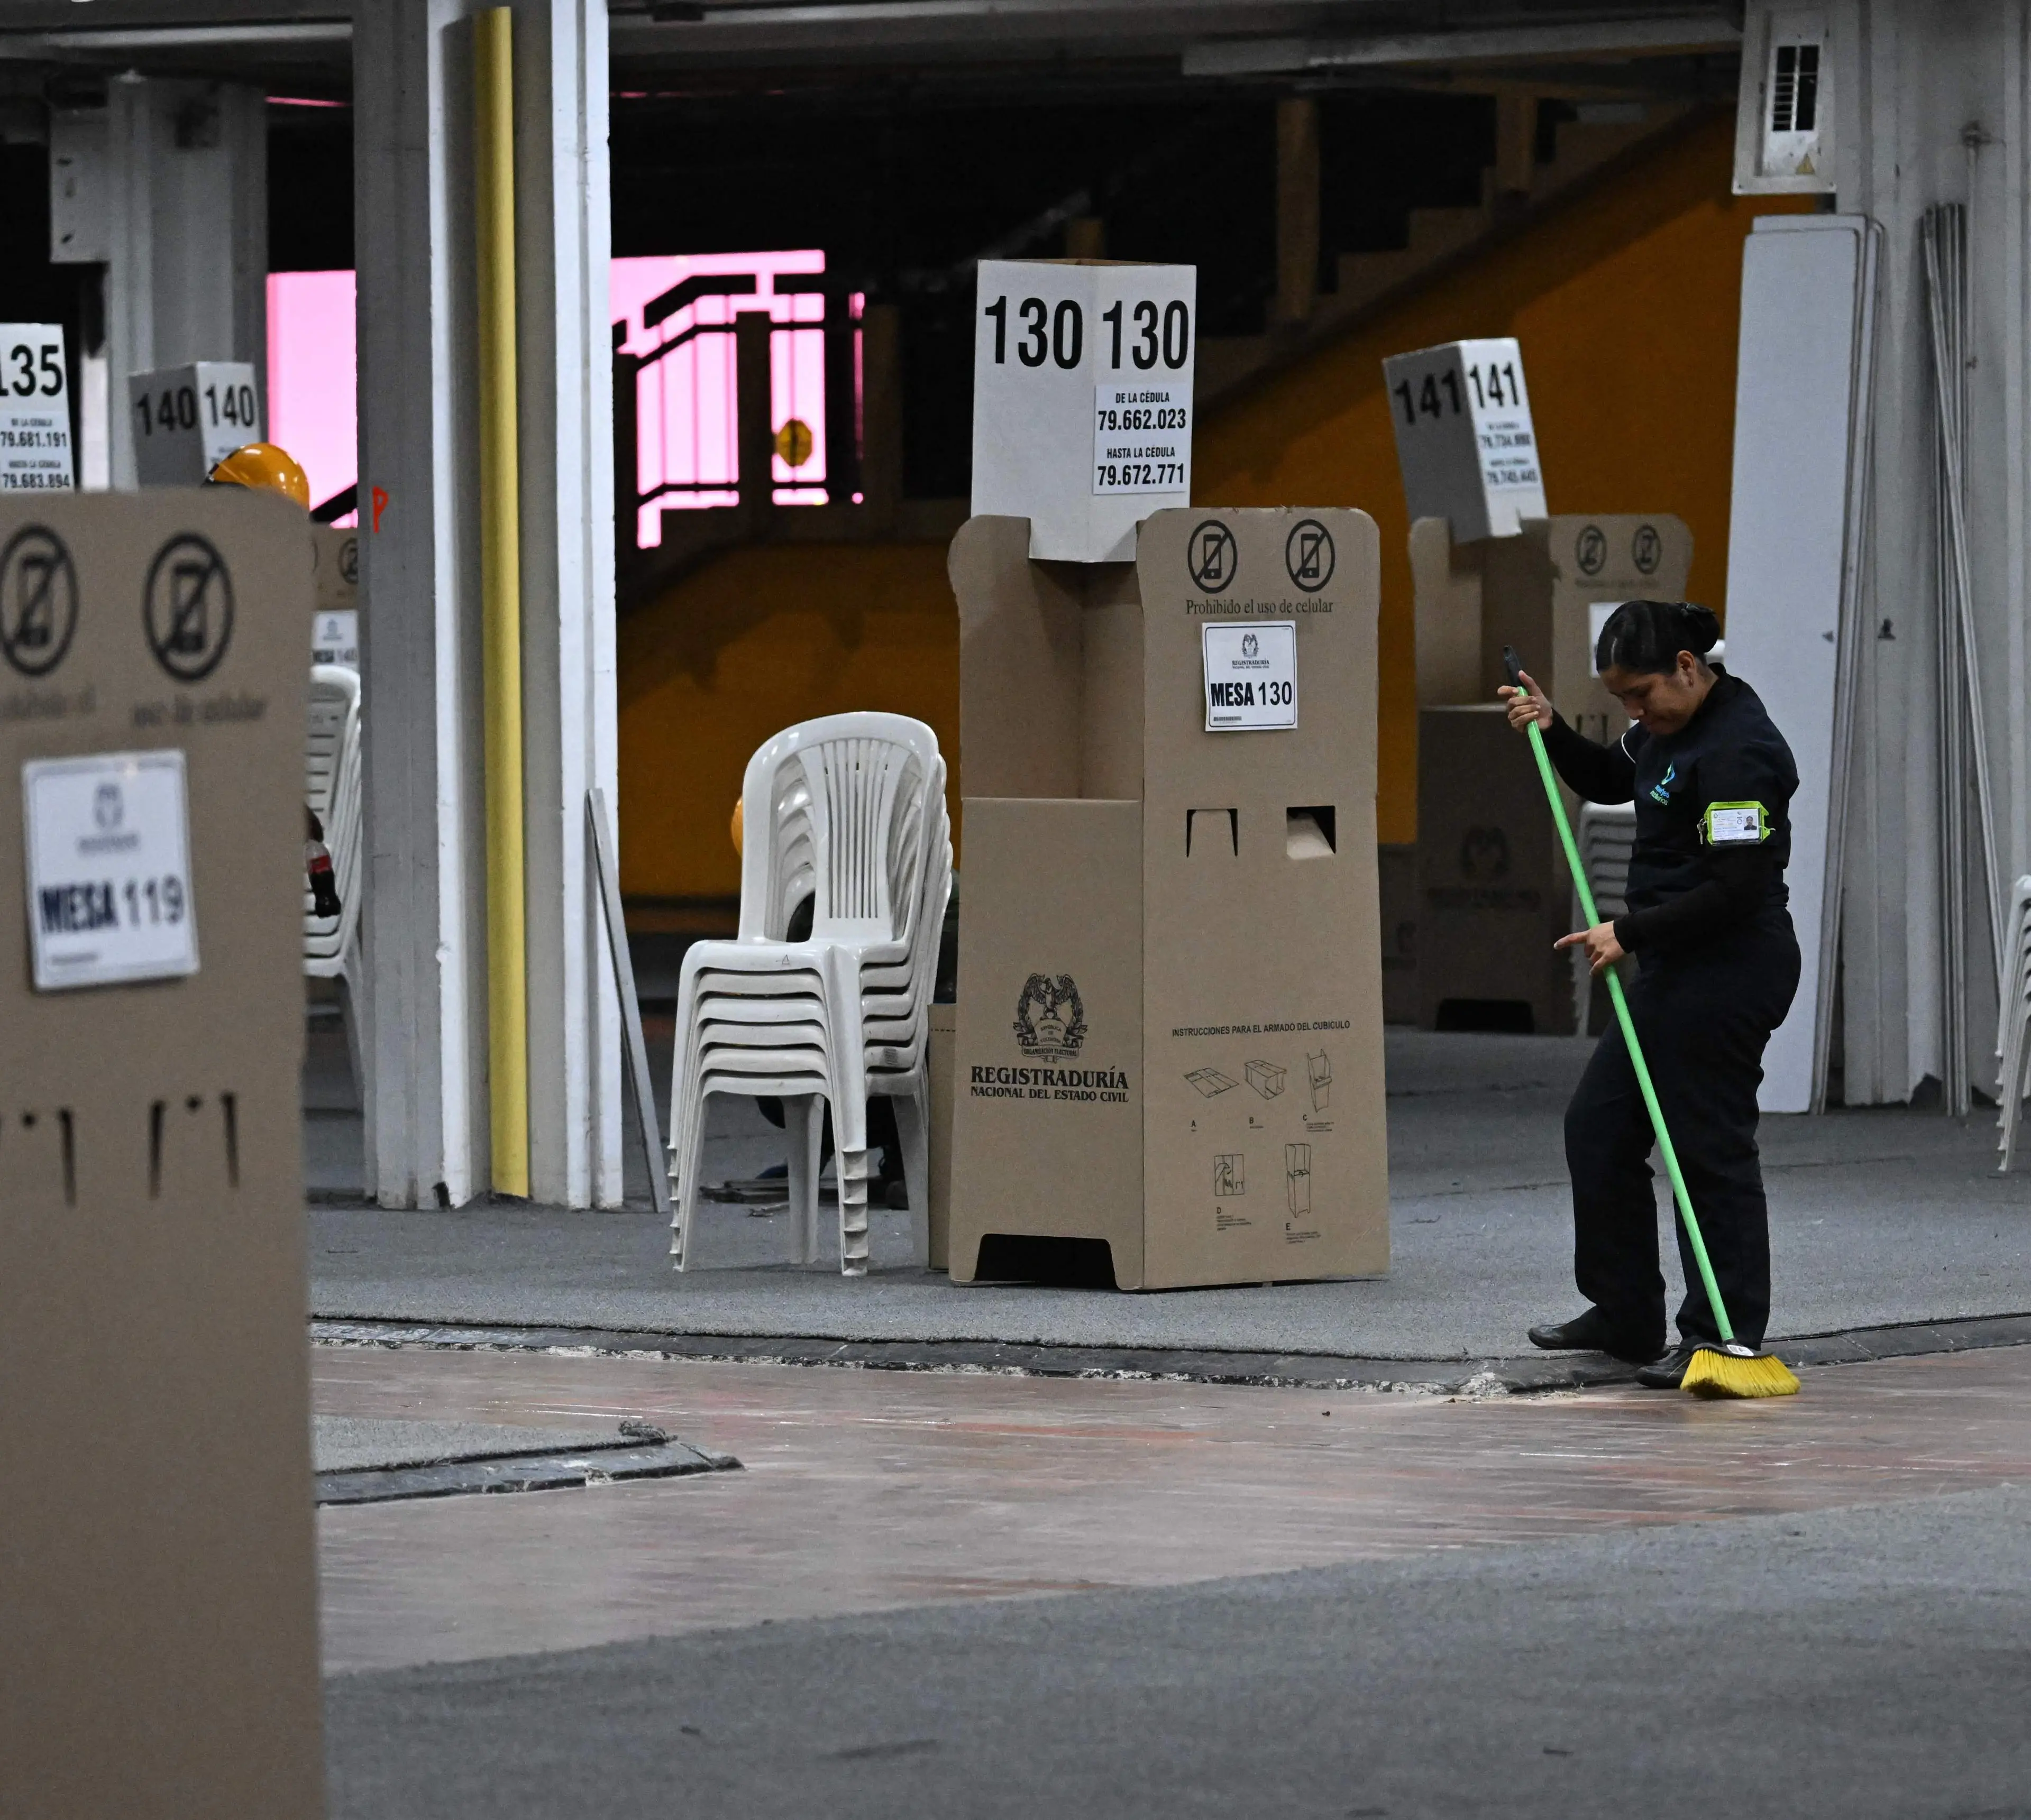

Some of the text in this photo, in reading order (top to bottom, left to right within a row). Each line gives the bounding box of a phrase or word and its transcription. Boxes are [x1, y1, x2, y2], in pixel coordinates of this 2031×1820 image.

[985, 296, 1083, 369] 130
[1103, 300, 1189, 370] 130
[1115, 390, 1170, 403] DE LA CÉDULA
[1395, 368, 1461, 425] 141
[1469, 362, 1520, 409] 141
[138, 385, 197, 436] 140
[205, 383, 254, 427] 140
[1098, 408, 1186, 430] 79.662.023
[1106, 445, 1175, 458] HASTA LA CÉDULA
[1097, 463, 1184, 486] 79.672.771
[372, 486, 389, 533] P
[1186, 598, 1333, 614] Prohibido el uso de celular
[1210, 681, 1292, 706] MESA 130
[123, 875, 184, 928] 119
[1172, 1026, 1230, 1036] INSTRUCCIONES
[1232, 1025, 1251, 1034] PARA
[1264, 1023, 1295, 1033] ARMADO
[1297, 1022, 1311, 1031] DEL
[971, 1065, 1129, 1089] REGISTRADURÍA
[971, 1087, 1129, 1102] NACIONAL DEL ESTADO CIVIL
